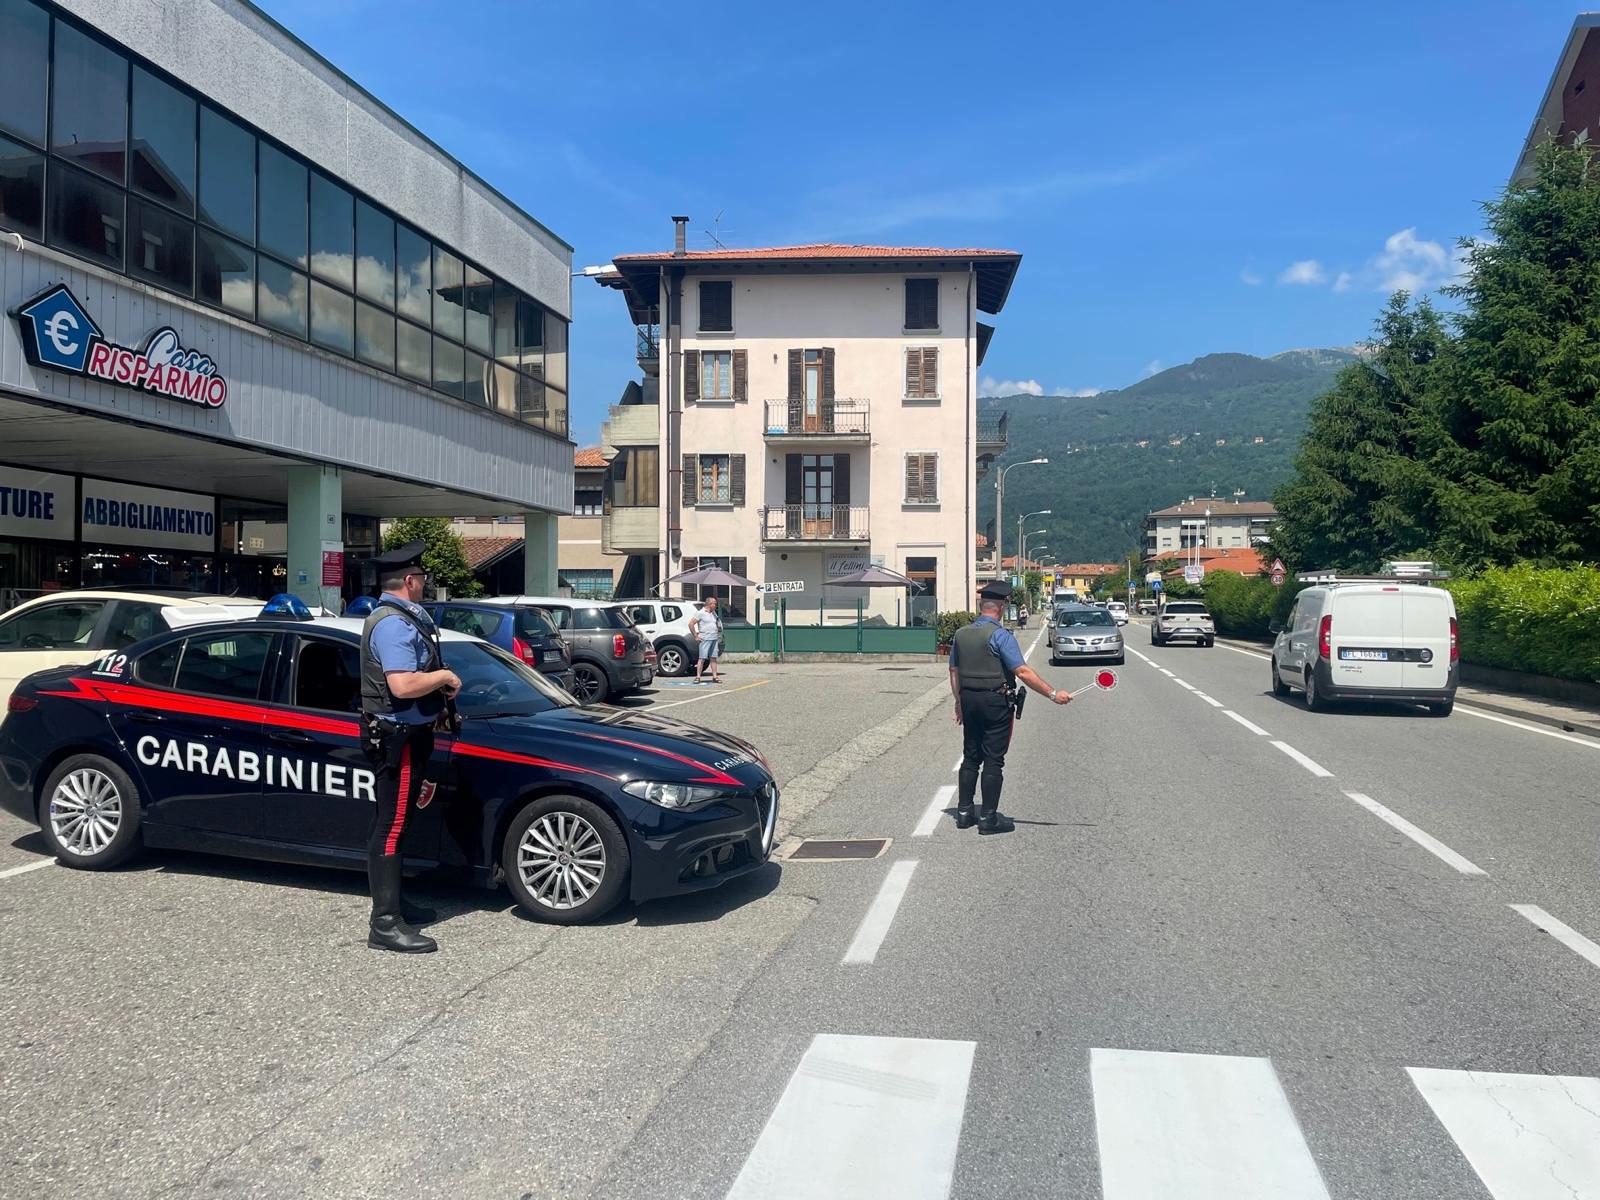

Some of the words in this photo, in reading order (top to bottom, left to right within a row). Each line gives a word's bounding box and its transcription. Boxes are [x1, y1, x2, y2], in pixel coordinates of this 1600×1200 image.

[147, 330, 216, 376] Casa
[90, 343, 226, 405] RISPARMIO
[0, 487, 54, 520] TURE
[84, 497, 214, 536] ABBIGLIAMENTO
[773, 582, 803, 592] ENTRATA
[97, 654, 127, 673] 112
[136, 735, 377, 802] CARABINIER
